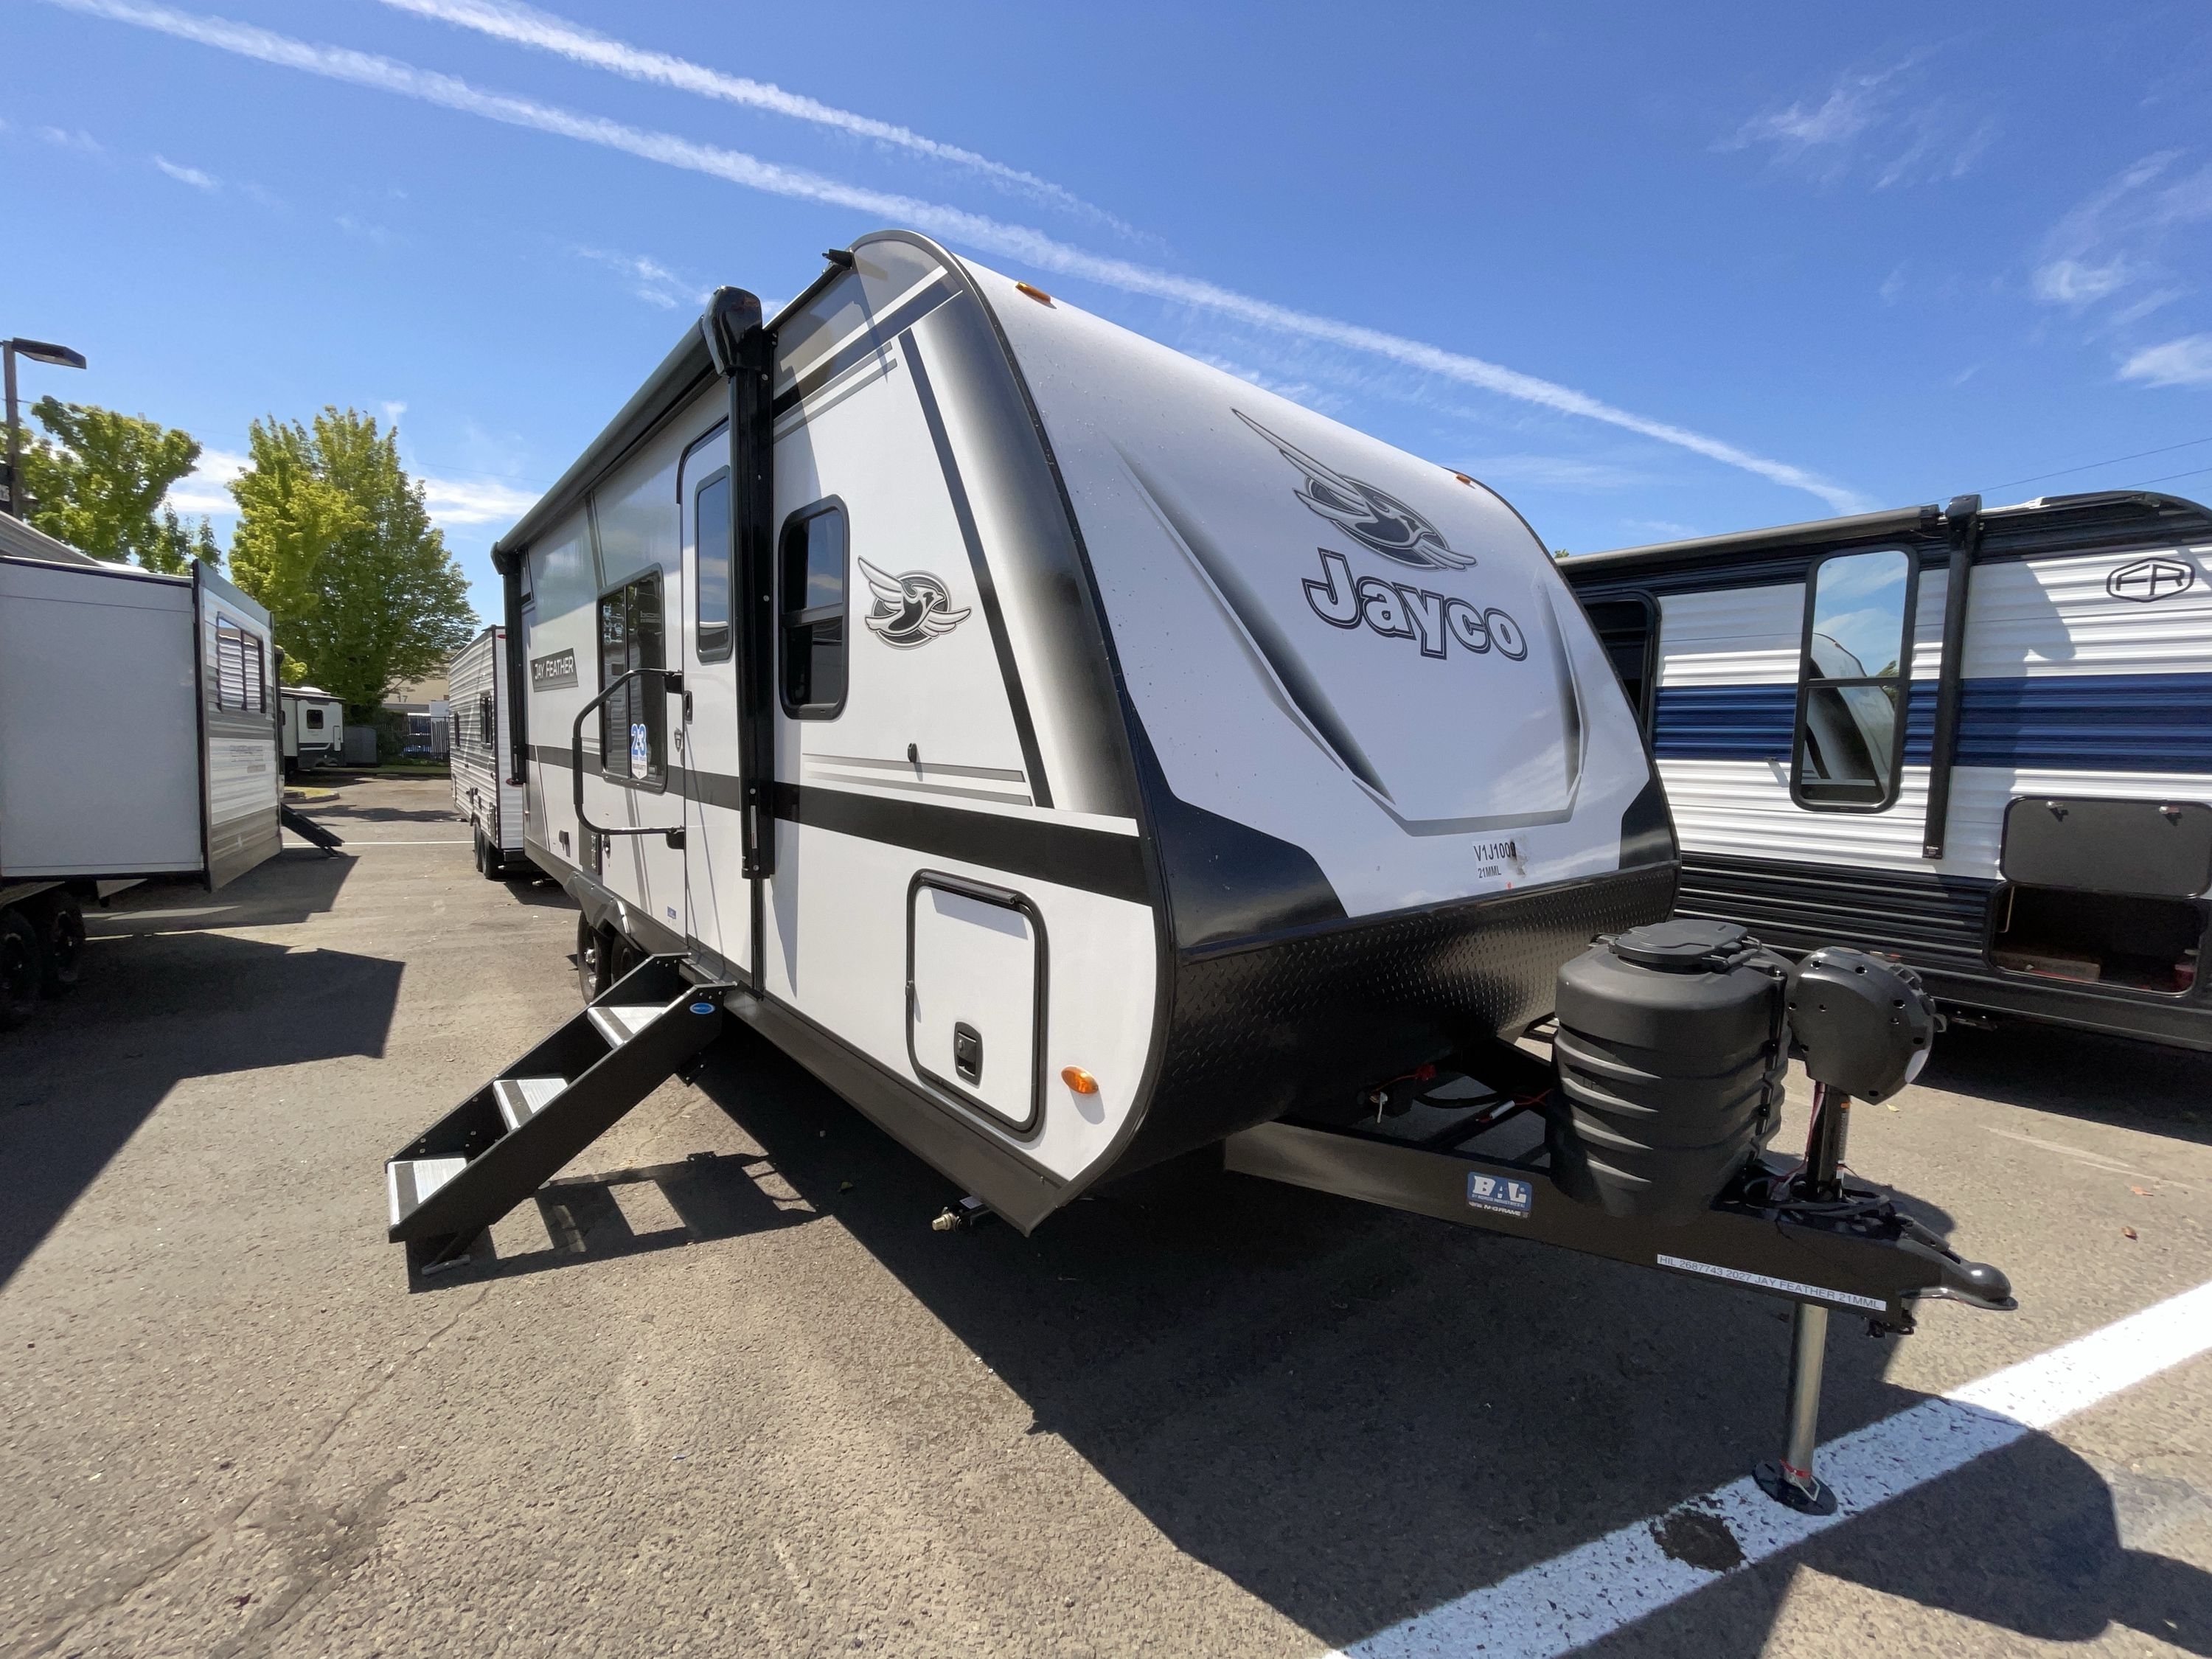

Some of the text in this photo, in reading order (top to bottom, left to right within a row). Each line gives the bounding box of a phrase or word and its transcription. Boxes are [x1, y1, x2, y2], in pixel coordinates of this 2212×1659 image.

[1301, 547, 1528, 661] Jayco
[535, 655, 574, 680] JAY FEATHER
[1478, 865, 1502, 879] 21MML
[1659, 1256, 1880, 1310] HIL 2687743 2027 JAY FEATHER 21MML
